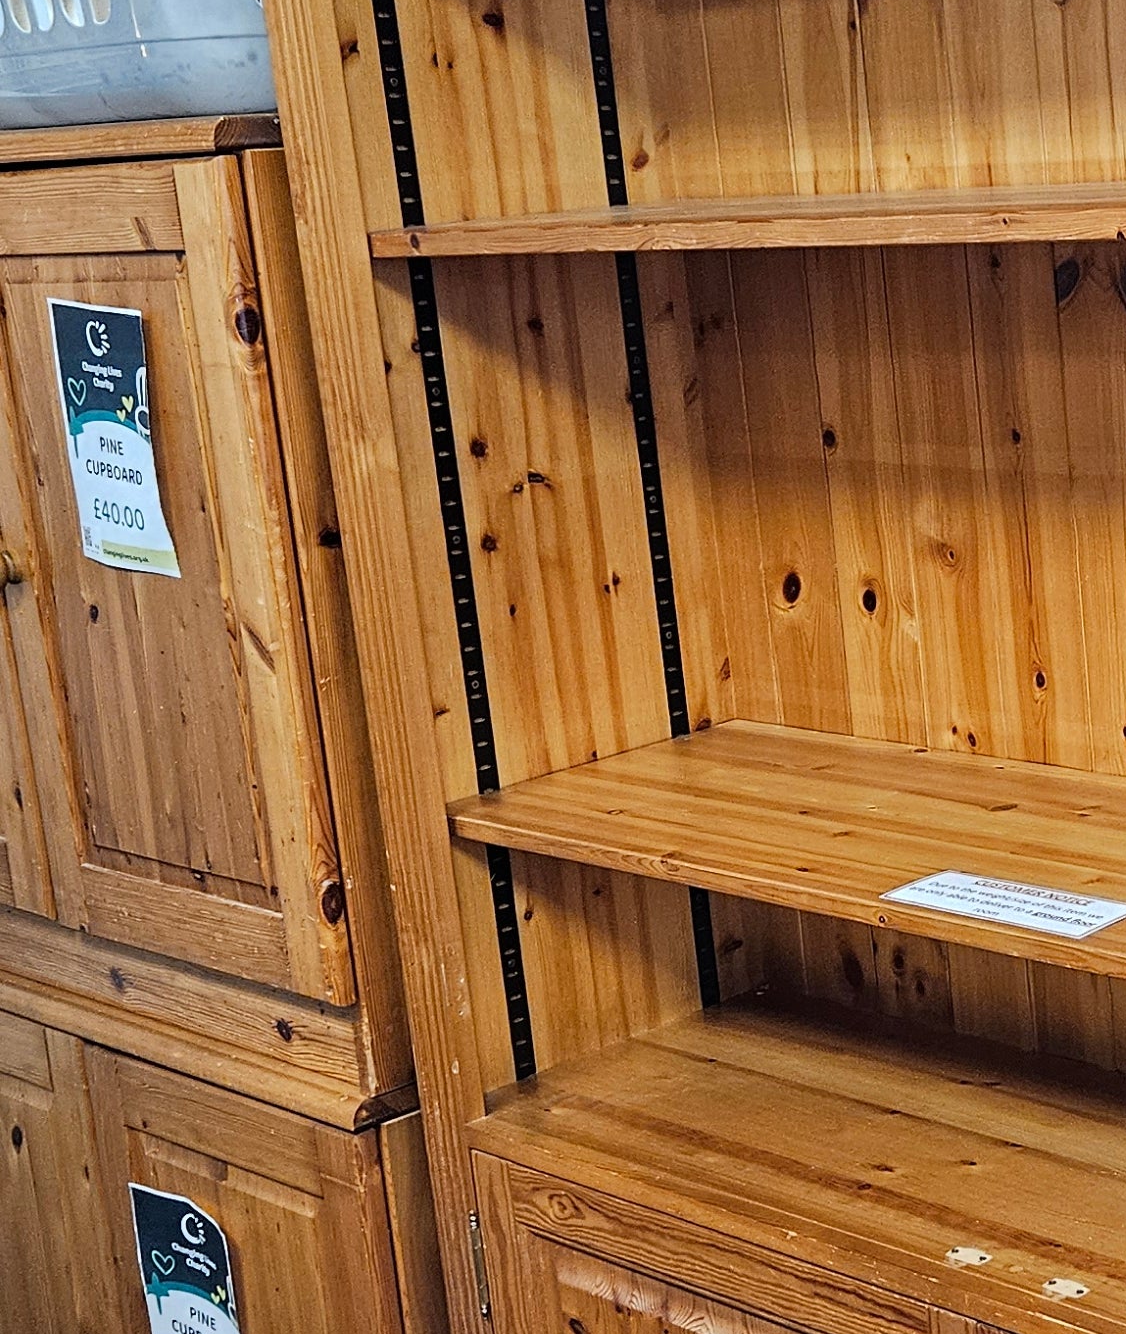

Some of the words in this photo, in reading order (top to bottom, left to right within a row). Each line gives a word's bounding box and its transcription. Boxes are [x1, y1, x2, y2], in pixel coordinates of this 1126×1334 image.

[99, 436, 124, 457] PINE
[85, 458, 143, 486] CUPBOARD
[93, 497, 145, 531] £40.00
[972, 879, 1044, 899] CUSTOMER
[1031, 911, 1073, 923] ground
[189, 1306, 217, 1331] PINE
